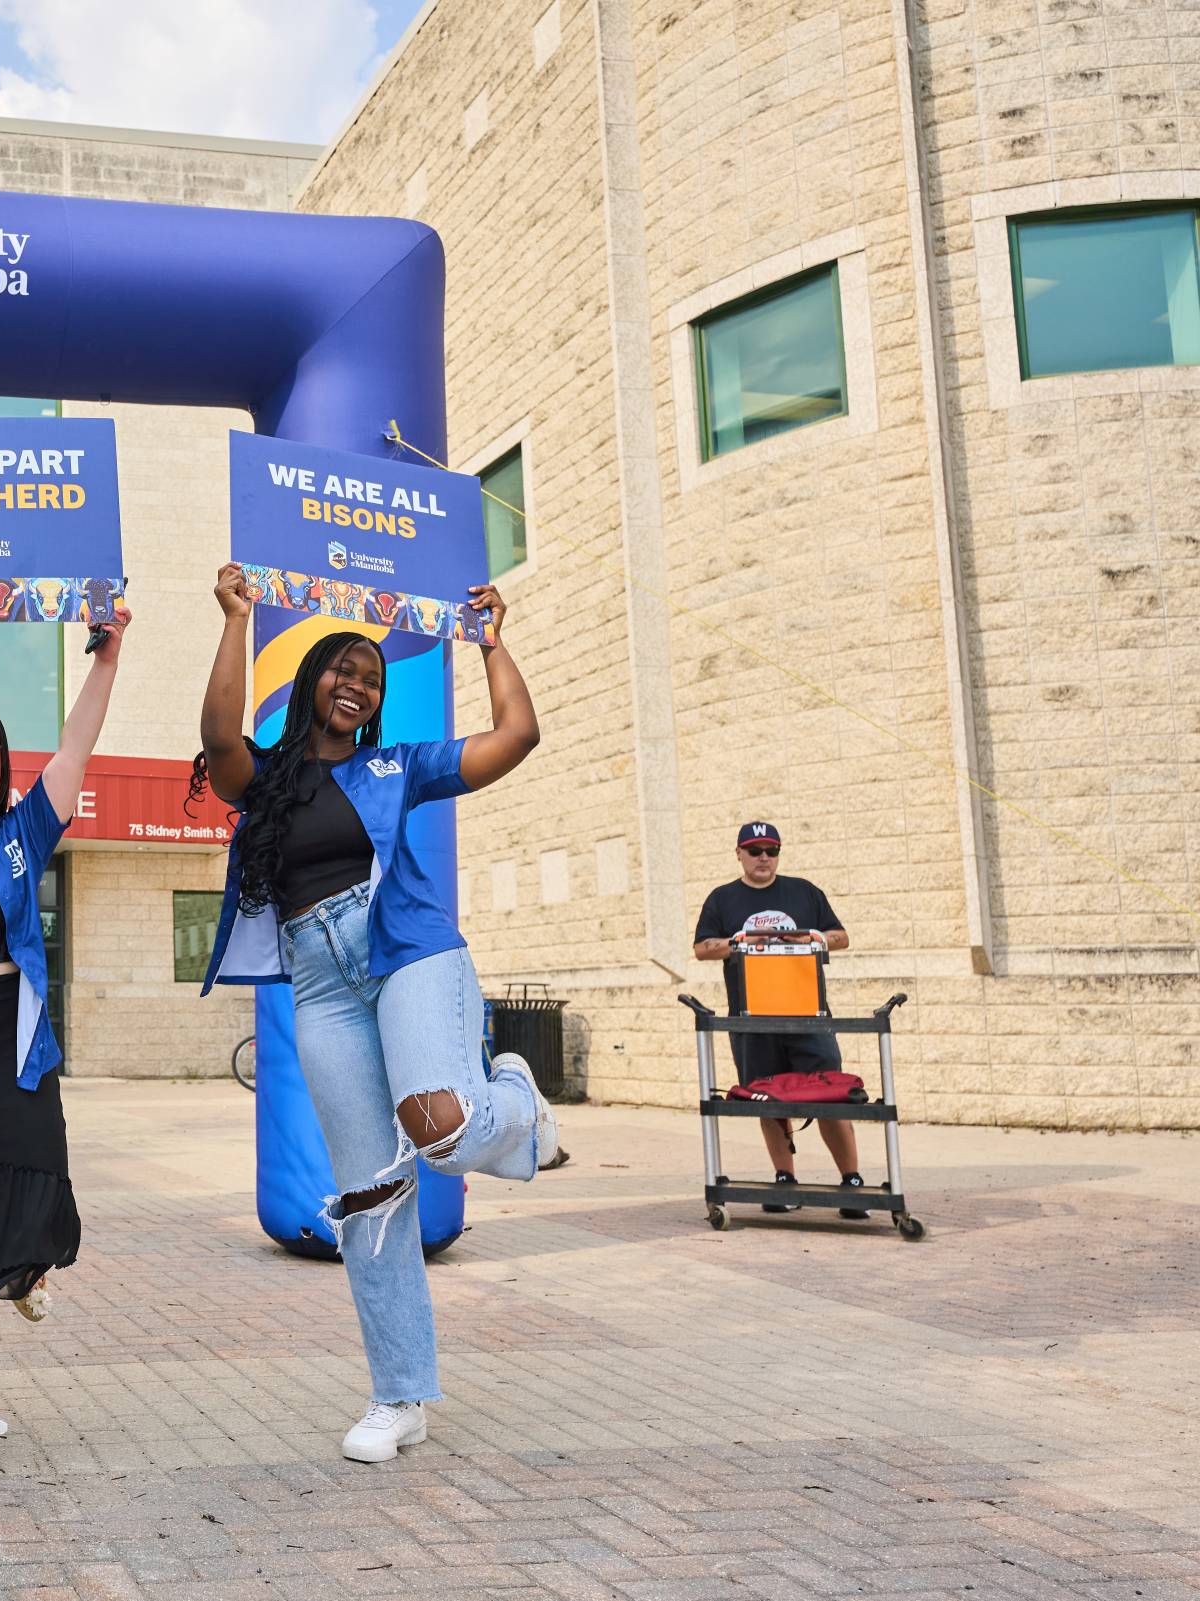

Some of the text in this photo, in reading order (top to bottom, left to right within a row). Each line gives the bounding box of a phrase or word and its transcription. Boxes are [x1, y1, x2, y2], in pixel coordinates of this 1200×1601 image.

[268, 463, 447, 517] WE ARE ALL
[302, 497, 417, 538] BISONS
[350, 551, 395, 568] University
[355, 560, 395, 575] Manitoba
[129, 823, 230, 839] 75 Sidney Smith St.
[752, 824, 767, 837] W
